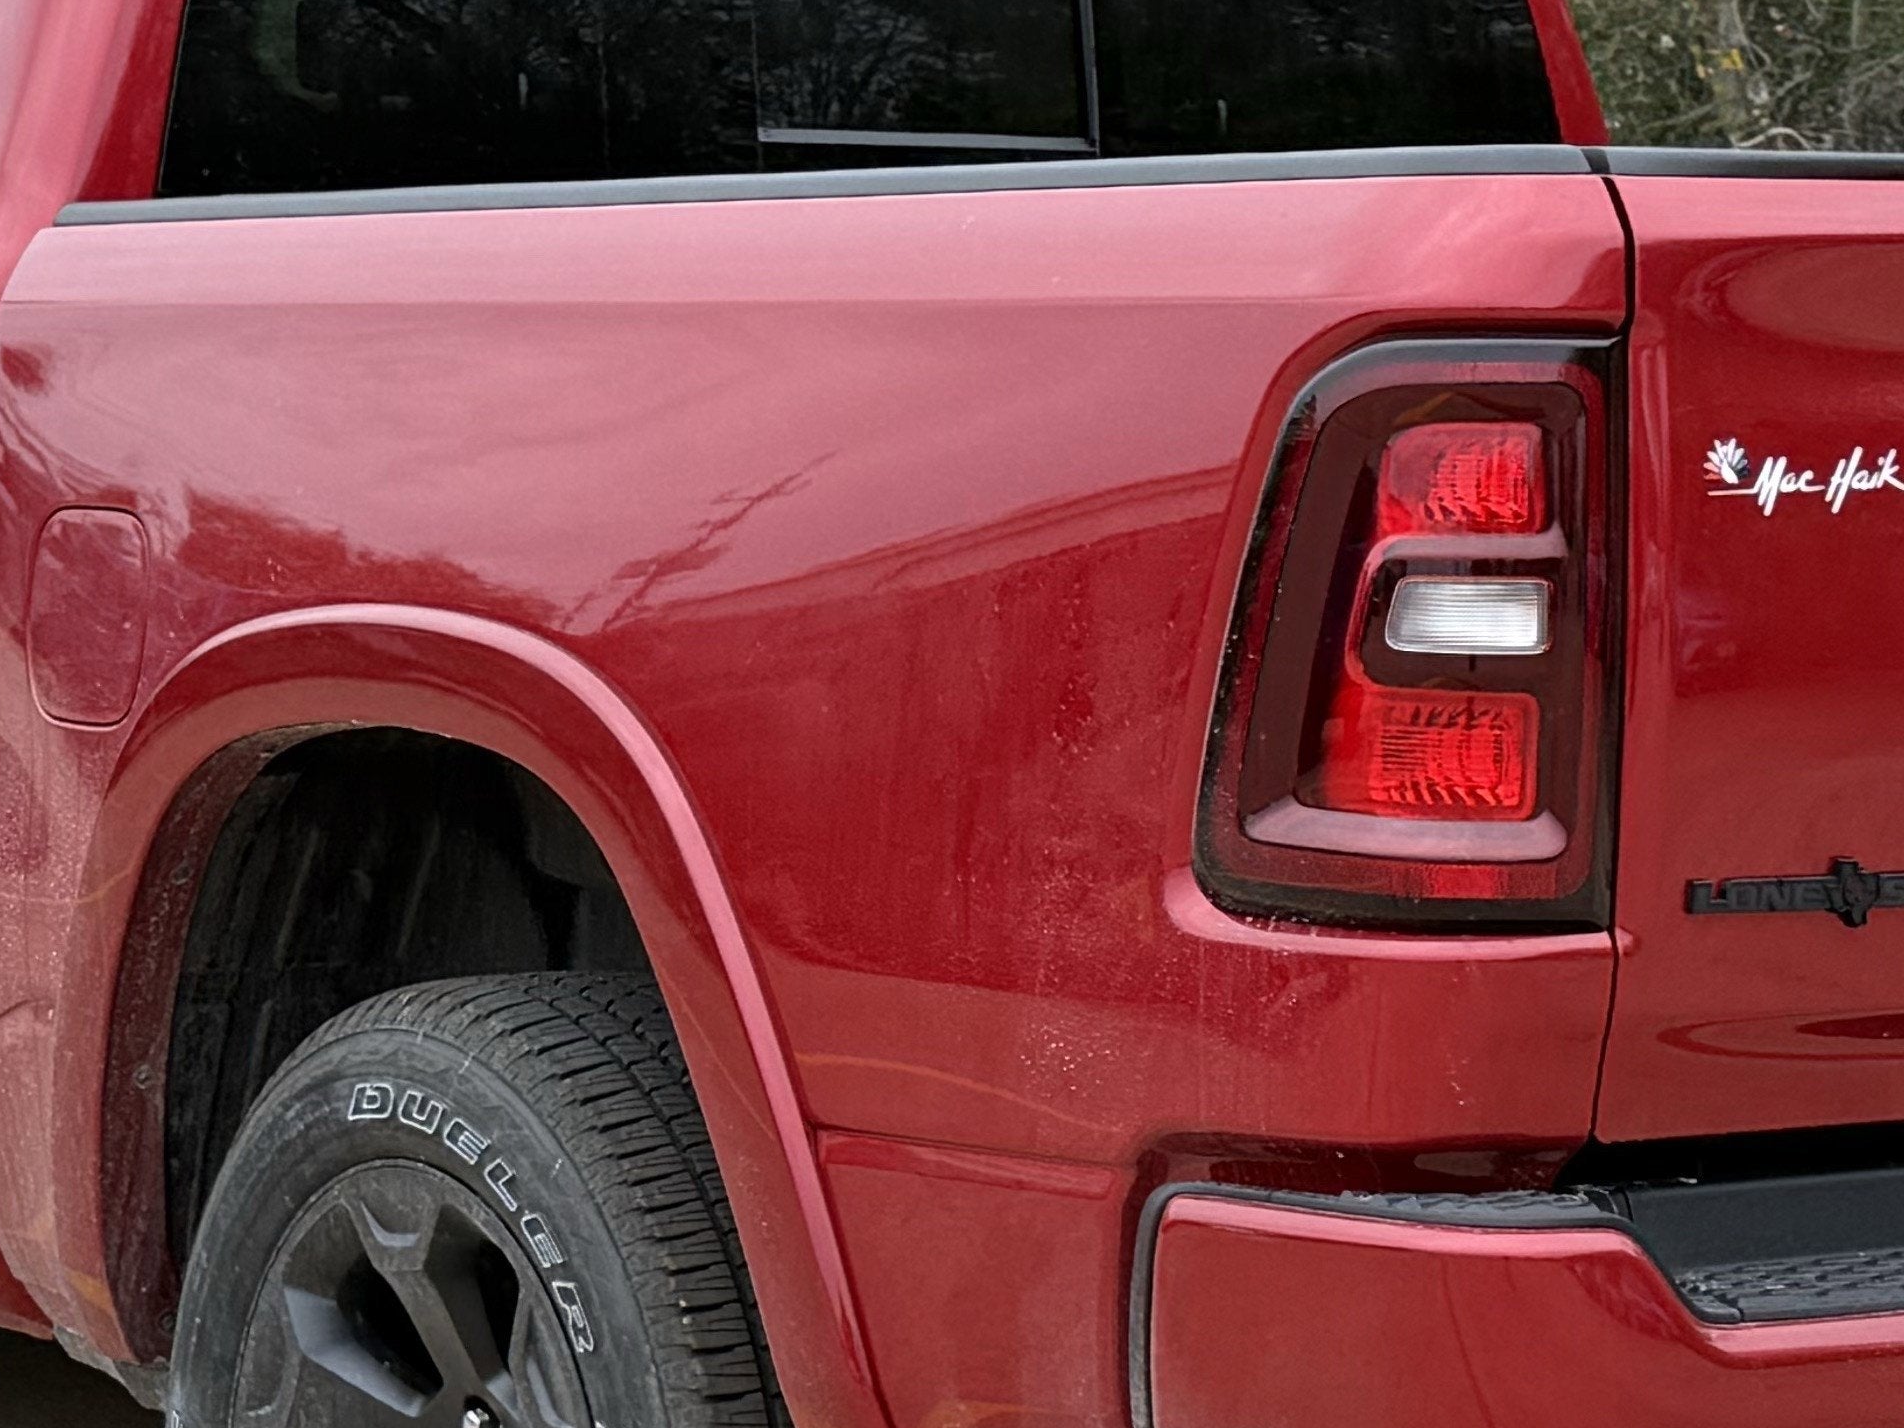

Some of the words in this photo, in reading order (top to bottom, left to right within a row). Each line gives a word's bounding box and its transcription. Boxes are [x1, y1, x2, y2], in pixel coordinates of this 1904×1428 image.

[1731, 456, 1825, 516] Mac
[1684, 875, 1829, 914] LONE
[347, 1082, 595, 1354] DUELER
